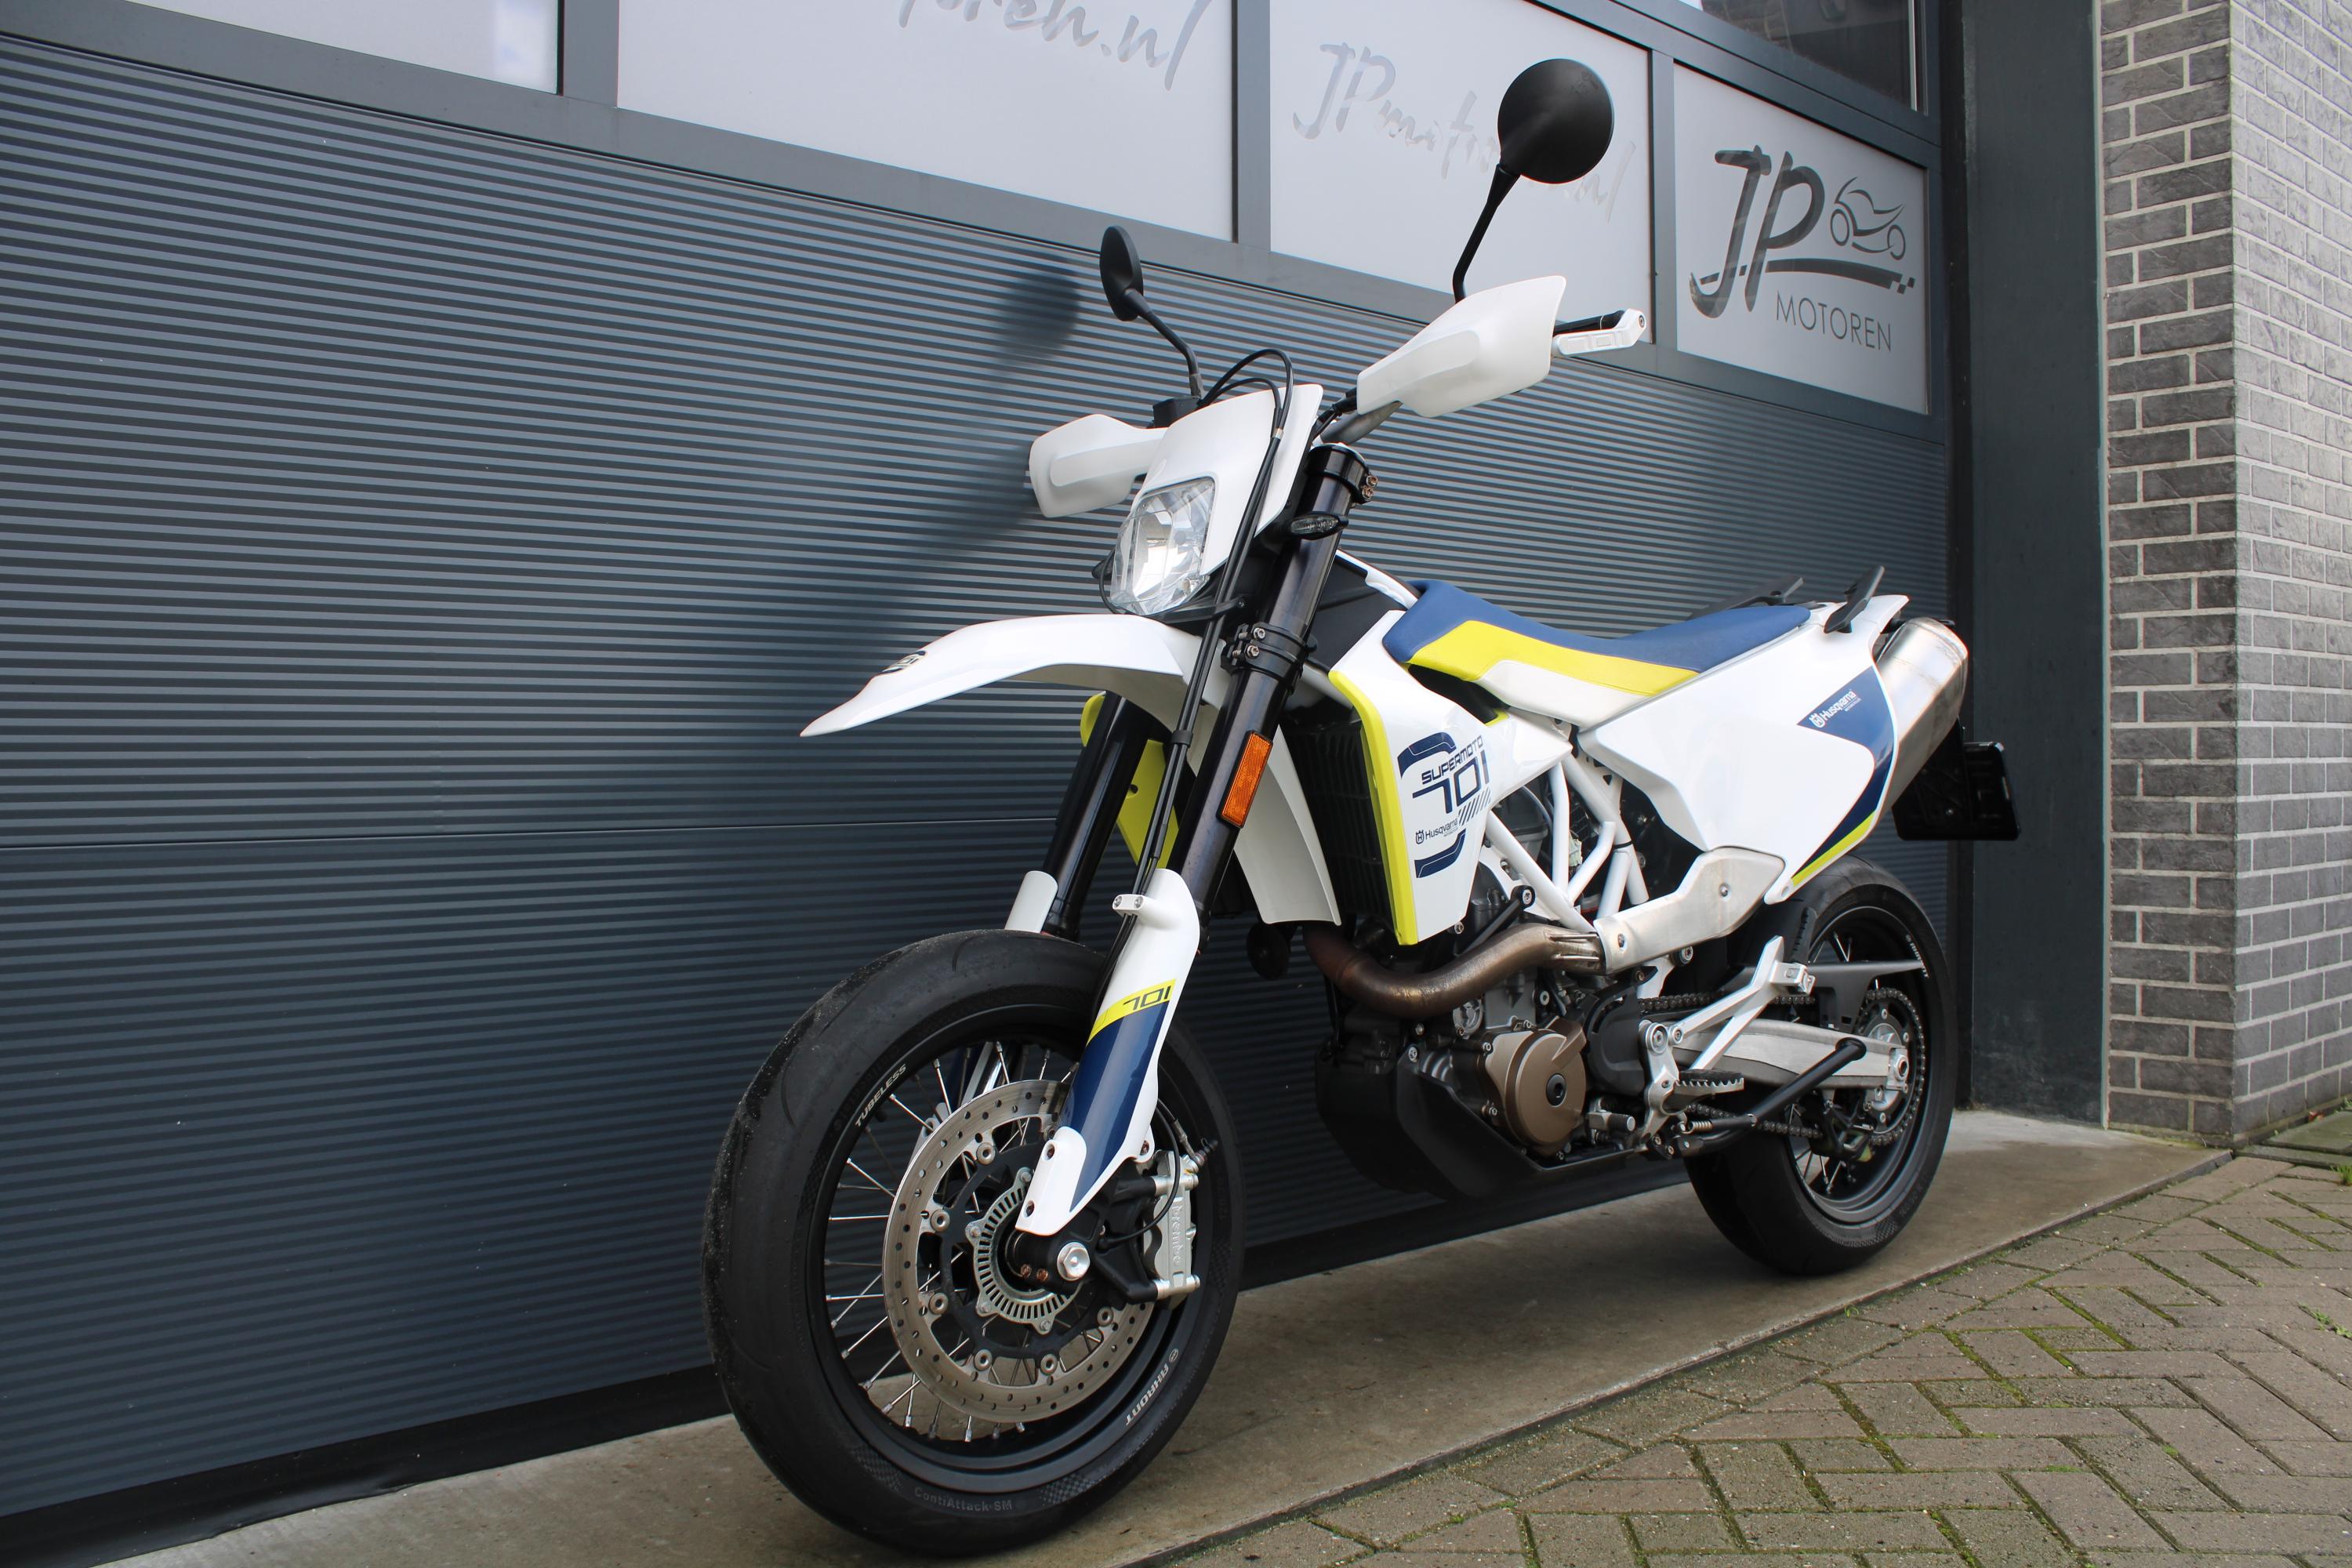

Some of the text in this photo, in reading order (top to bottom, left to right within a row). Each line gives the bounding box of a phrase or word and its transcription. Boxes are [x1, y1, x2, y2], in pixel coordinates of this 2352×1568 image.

[1690, 144, 1825, 318] JP
[1776, 290, 1891, 352] MOTOREN
[1819, 690, 1857, 721] Husqvarna
[1412, 750, 1490, 814] 701
[1421, 735, 1483, 785] SUPERMOTO
[1425, 818, 1458, 840] Husqvarna
[1122, 985, 1171, 1011] 701
[855, 1063, 907, 1127] TUBELESS
